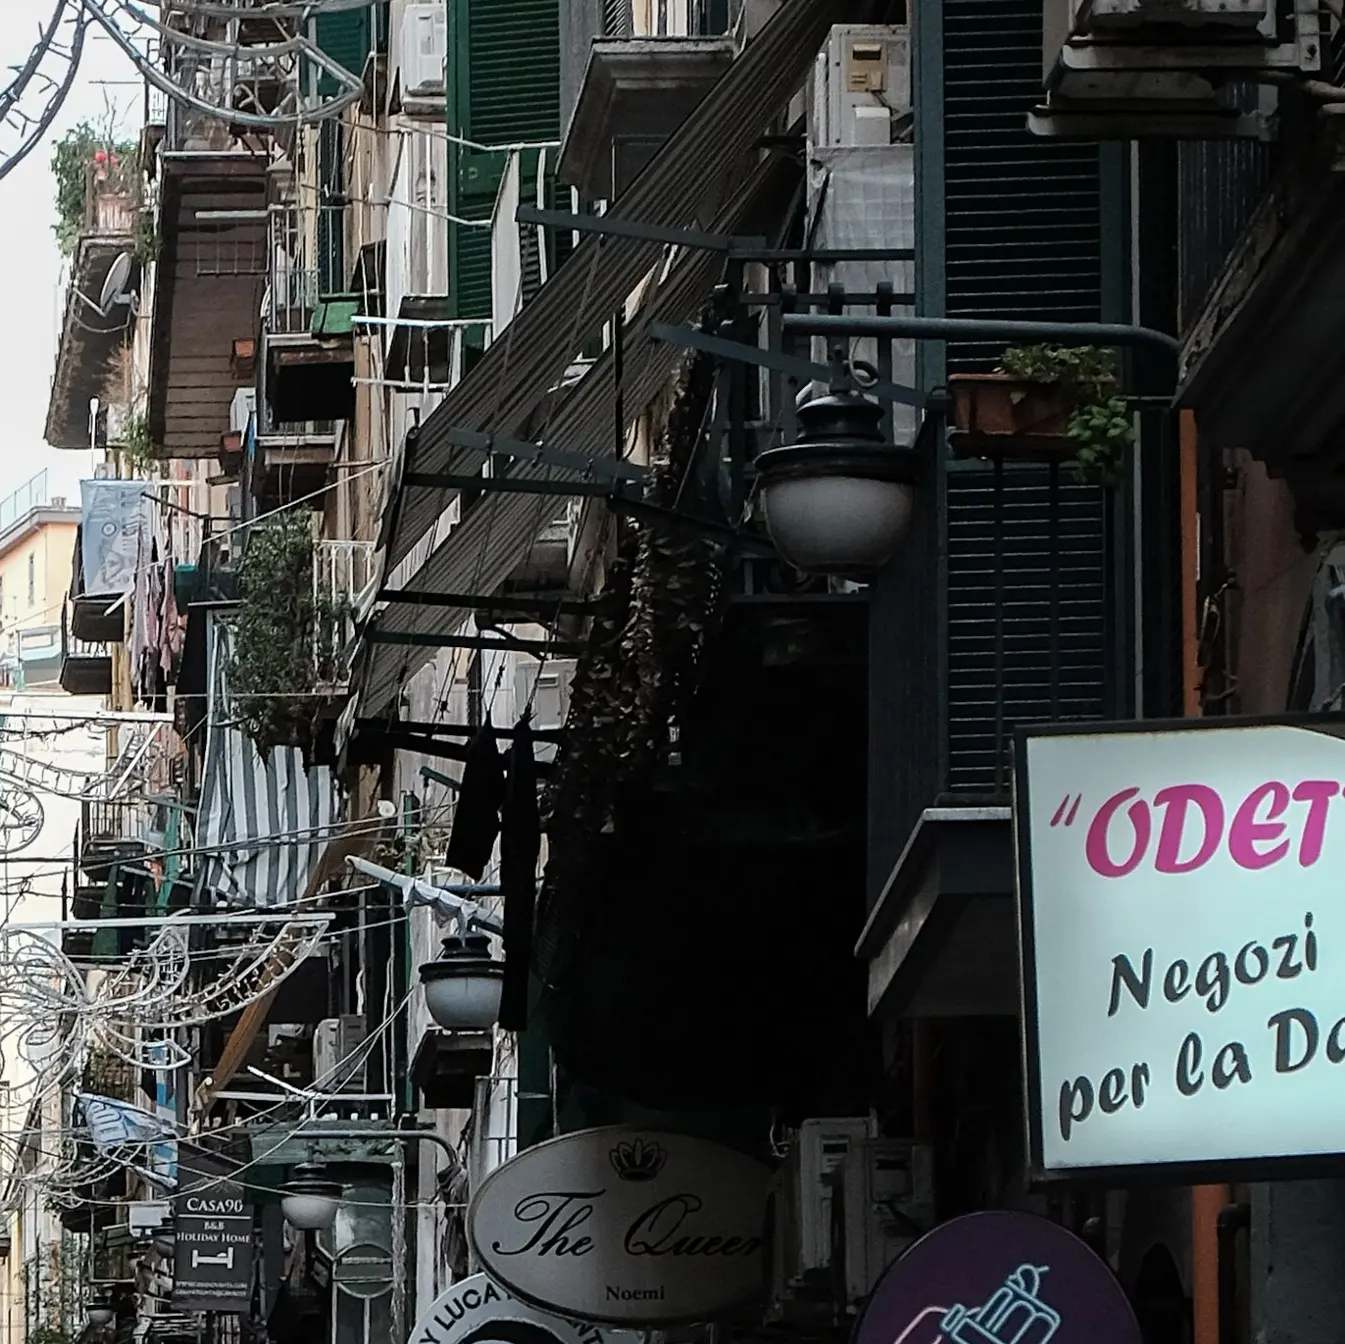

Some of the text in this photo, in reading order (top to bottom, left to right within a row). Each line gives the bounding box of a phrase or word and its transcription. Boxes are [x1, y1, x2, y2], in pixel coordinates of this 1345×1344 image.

[1050, 779, 1345, 879] "ODET
[1107, 911, 1317, 1018] Negozi
[1058, 1061, 1150, 1141] per
[1175, 1031, 1253, 1097] la
[492, 1189, 606, 1256] The
[433, 1281, 502, 1332] LUCA
[605, 1285, 665, 1302] Noemi
